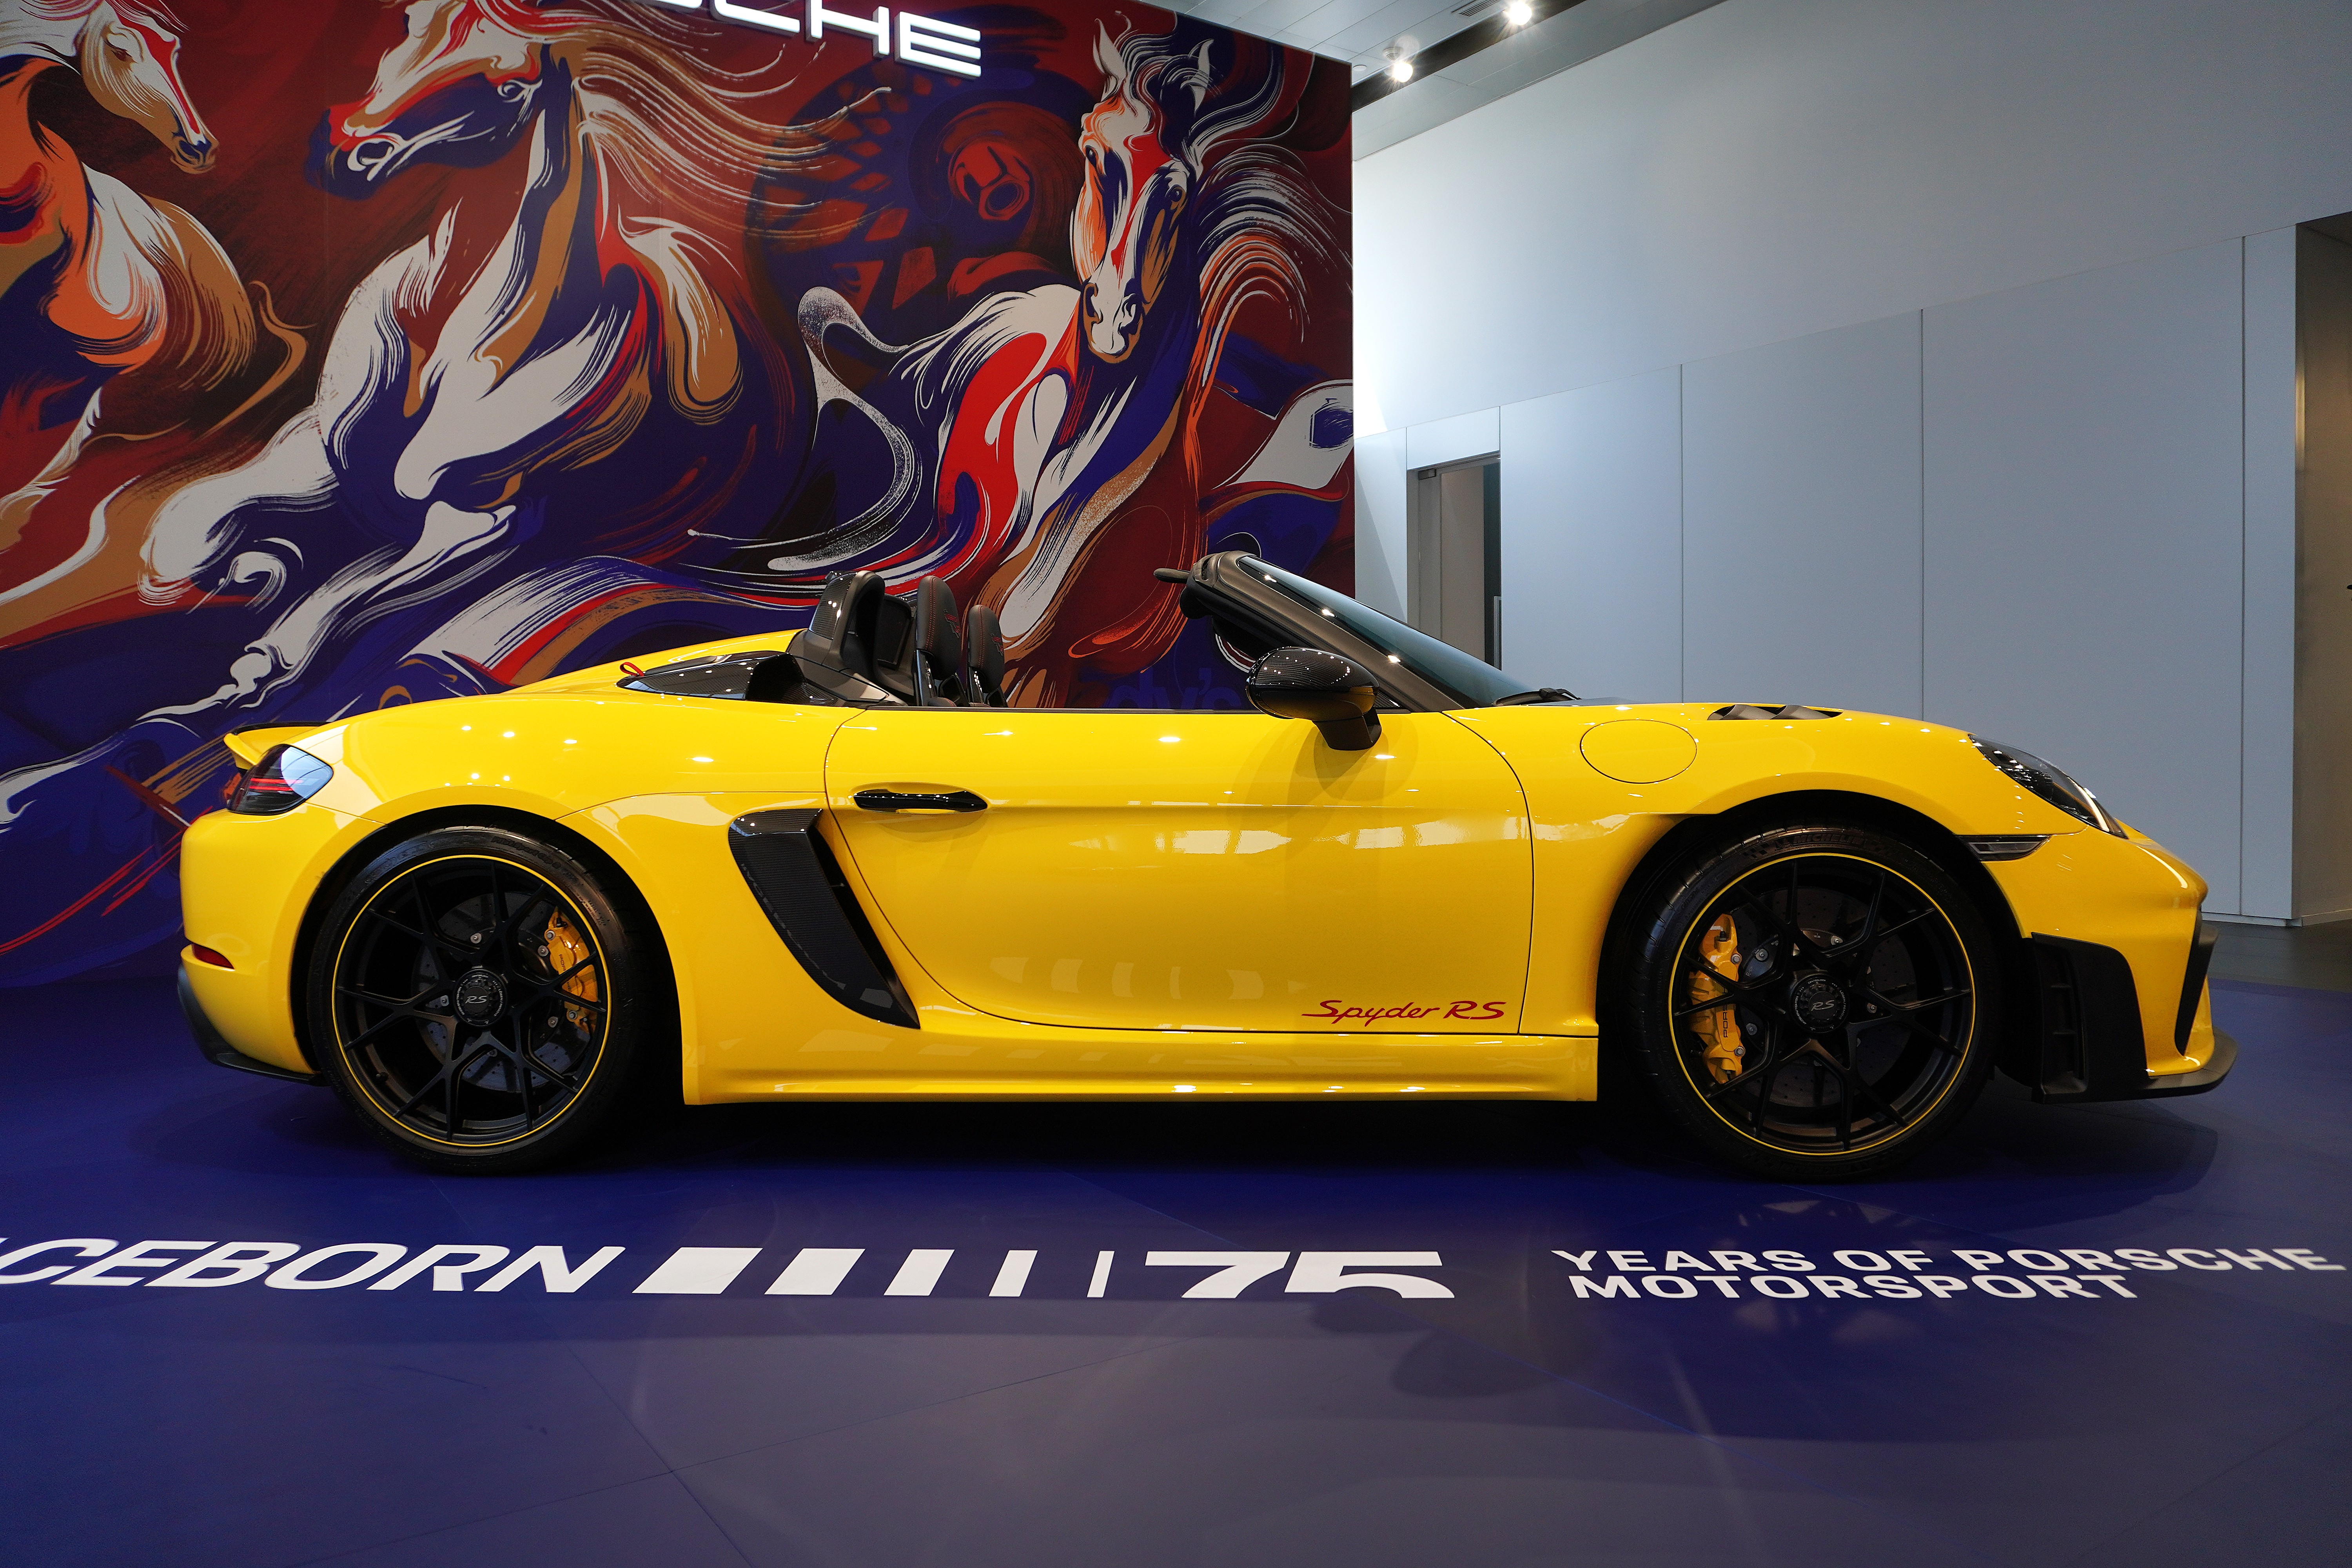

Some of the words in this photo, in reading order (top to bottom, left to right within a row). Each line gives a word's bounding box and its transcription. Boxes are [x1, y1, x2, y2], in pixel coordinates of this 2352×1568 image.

[643, 0, 981, 75] HE
[1794, 833, 1865, 845] MICHELIN
[465, 996, 488, 1004] RS
[1811, 1000, 1835, 1011] RS
[1301, 1000, 1440, 1027] Spyder
[1443, 1000, 1506, 1020] RS
[0, 1238, 626, 1293] CEBORN
[1551, 1250, 1816, 1271] YEARS
[1833, 1250, 1933, 1271] OF
[1951, 1248, 2347, 1271] PORSCHE
[1145, 1251, 1455, 1299] 75
[1568, 1275, 2138, 1299] MOTORSPORT
